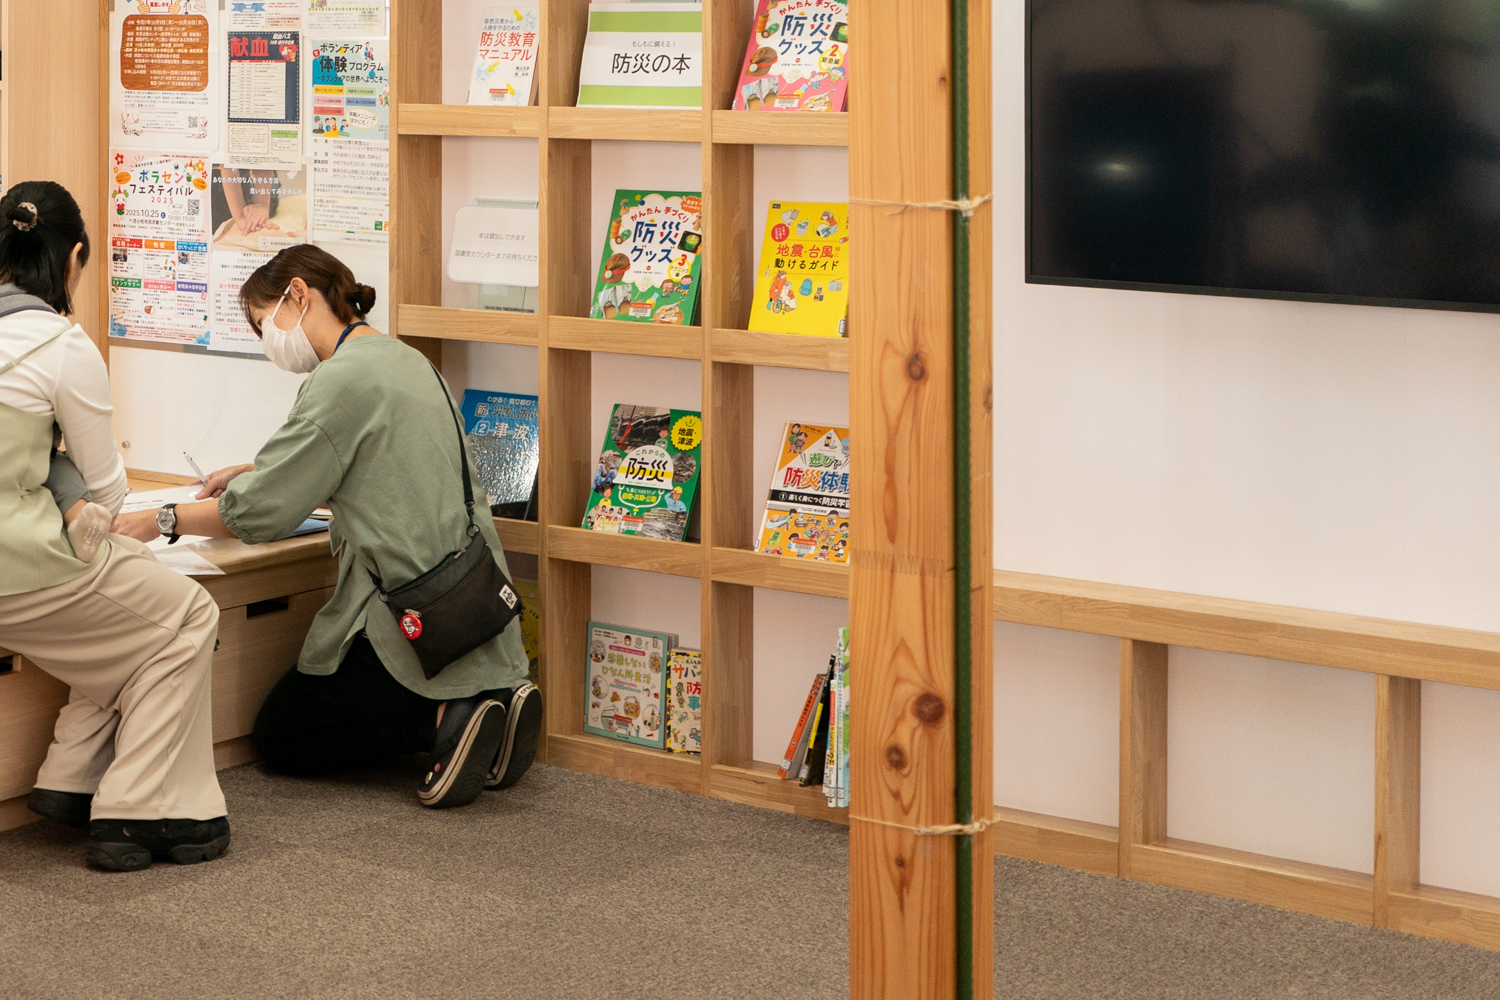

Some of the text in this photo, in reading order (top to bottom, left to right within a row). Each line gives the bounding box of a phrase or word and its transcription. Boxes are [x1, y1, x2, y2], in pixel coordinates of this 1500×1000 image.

[779, 0, 842, 15] かんたん 手づくり
[781, 13, 833, 37] 防災
[480, 32, 536, 47] 防災教育
[632, 40, 676, 48] もしもに備える！
[779, 38, 826, 55] グッズ
[229, 37, 269, 57] 献血
[320, 43, 363, 54] ボランティア
[829, 44, 839, 57] 2
[479, 49, 532, 61] マニュアル
[319, 55, 384, 73] 体験 プログラム
[612, 53, 692, 75] 防災の本
[139, 169, 184, 184] ボラセン
[213, 176, 279, 184] あなたの大切な人を守る方法
[129, 184, 193, 196] フェスティバル
[151, 196, 173, 204] 2025
[125, 209, 159, 218] 2025.10.25
[630, 206, 689, 223] かんたん 手づくり
[478, 232, 526, 241] 本は貸出しできます
[633, 221, 681, 245] 防災
[630, 245, 675, 263] グッズ
[776, 244, 834, 258] 地震・台風
[677, 254, 687, 266] 3
[774, 258, 839, 271] 動けるガイド
[492, 422, 530, 440] 津波
[677, 437, 694, 446] 津波
[636, 449, 665, 458] これからの
[809, 453, 841, 469] 遊びで
[625, 457, 668, 482] 防災
